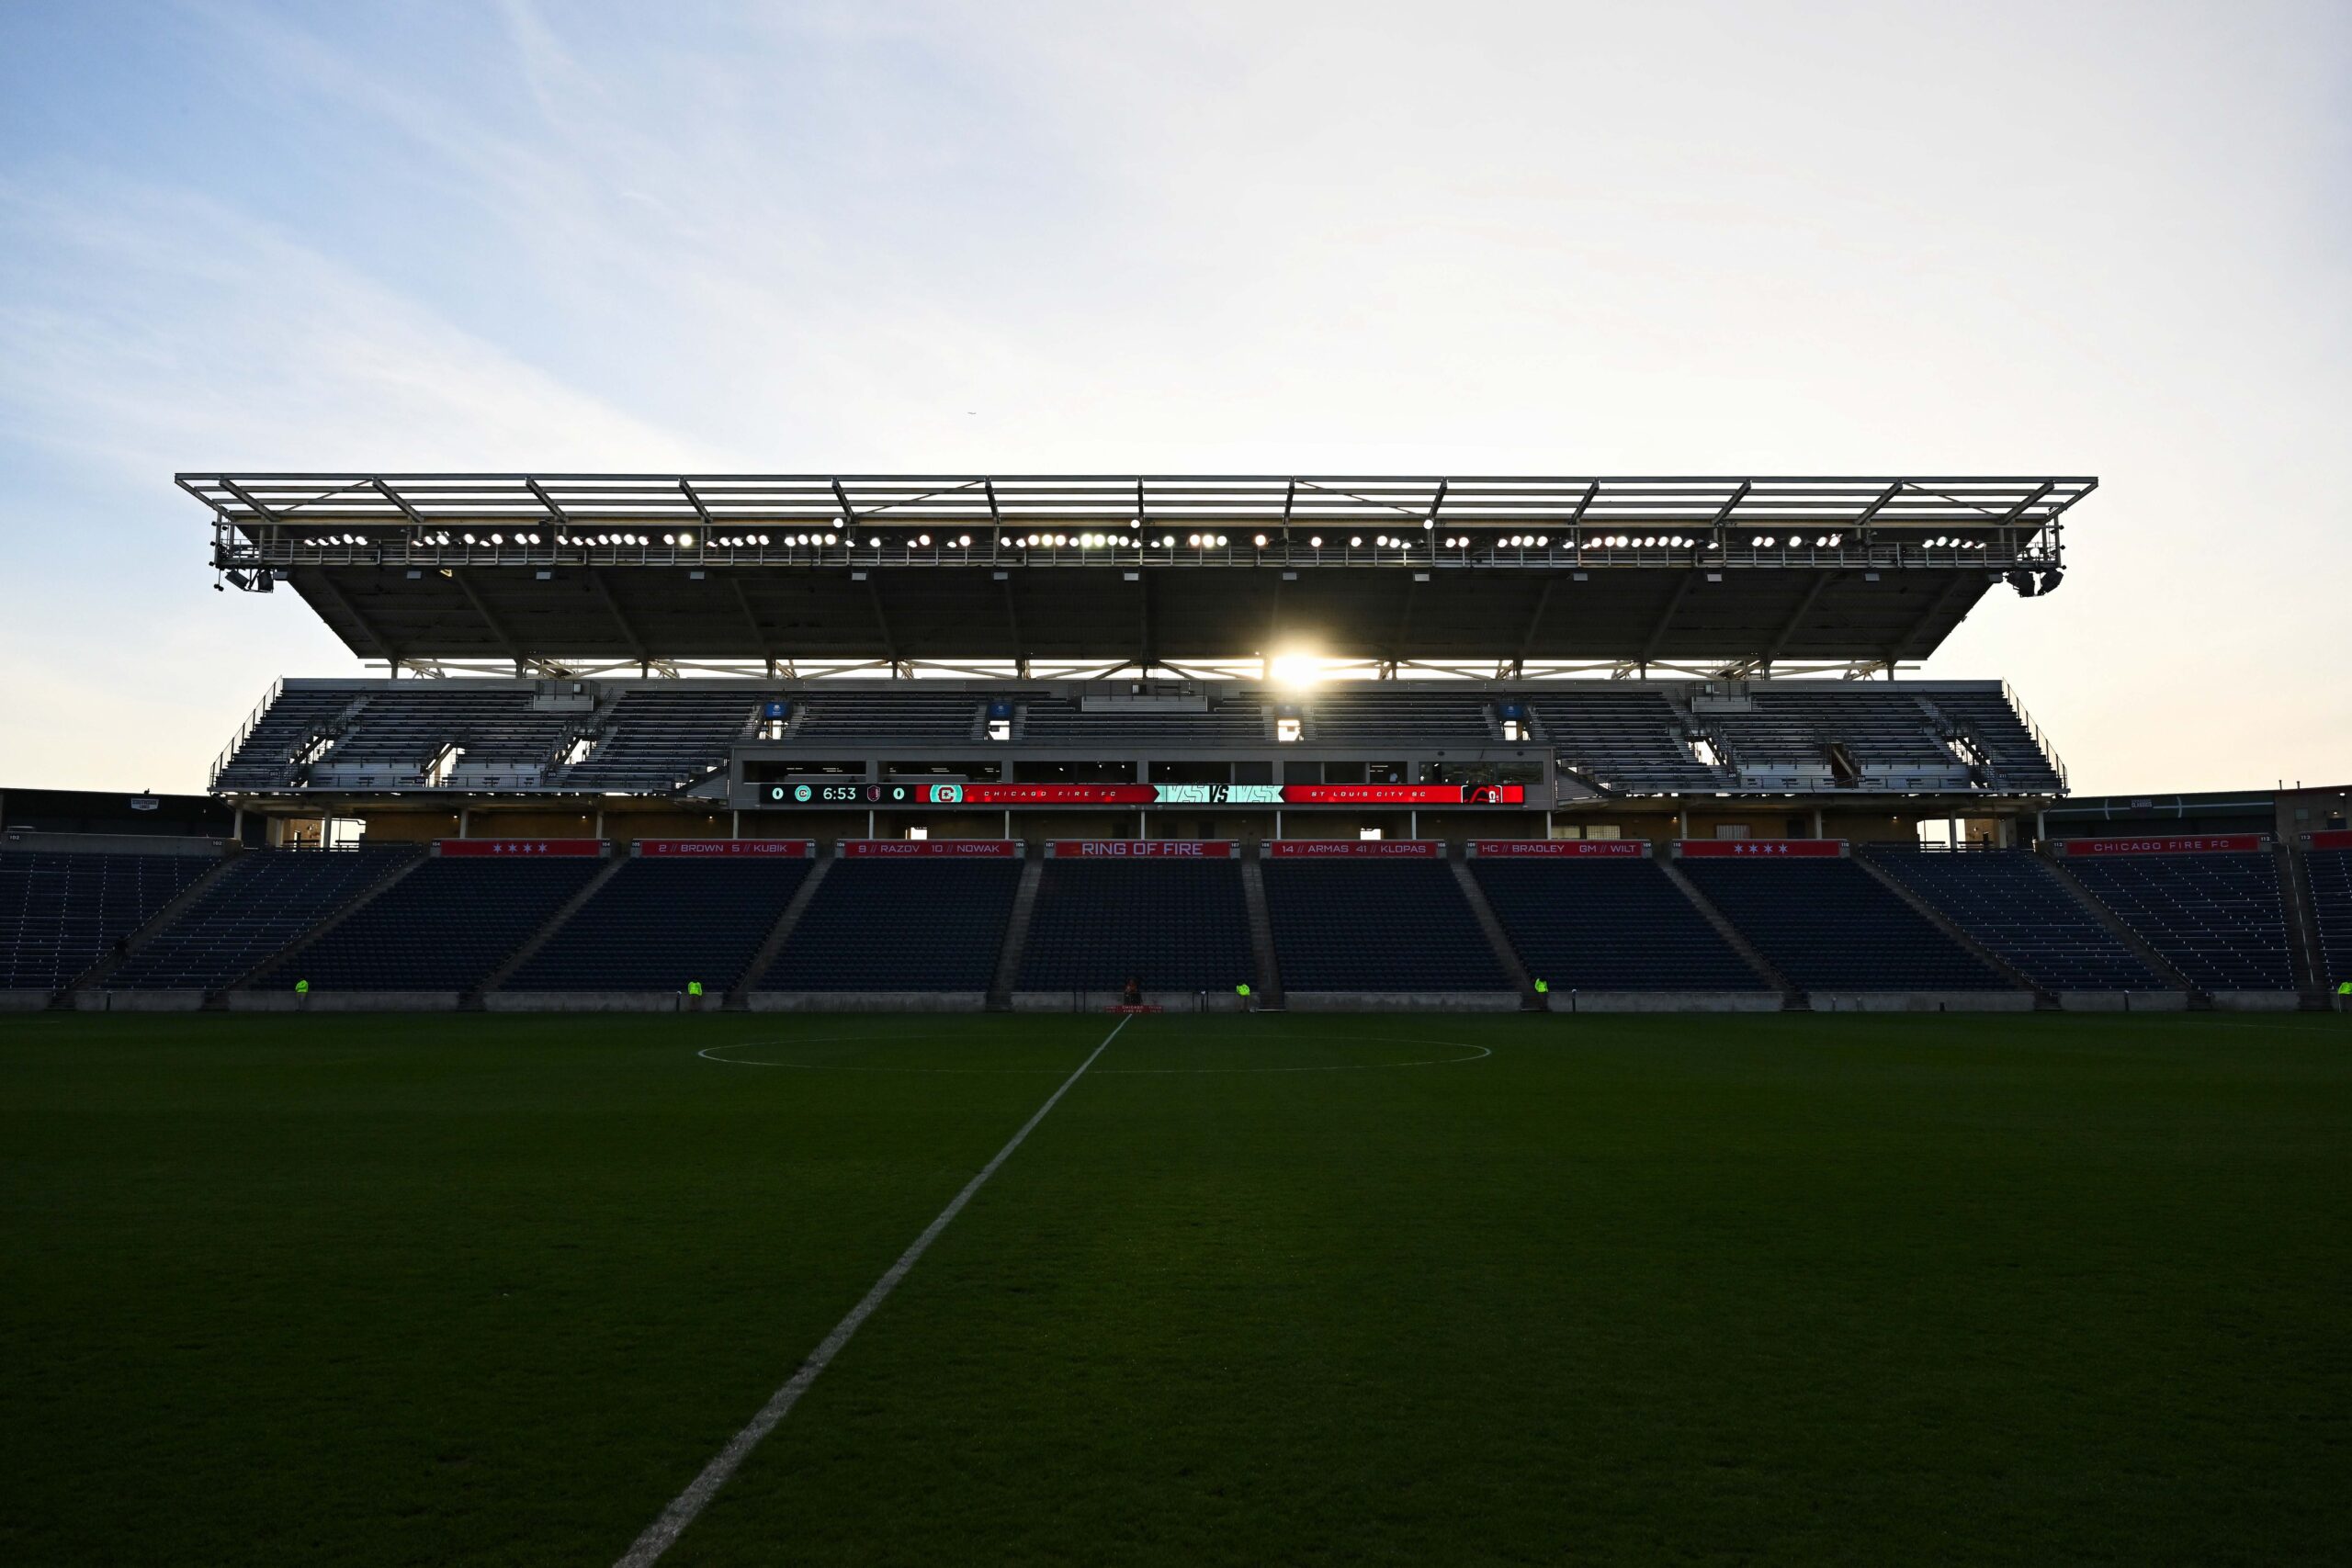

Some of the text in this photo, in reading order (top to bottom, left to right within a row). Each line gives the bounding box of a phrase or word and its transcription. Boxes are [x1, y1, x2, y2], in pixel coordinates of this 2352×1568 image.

[772, 787, 784, 800] 0
[822, 787, 856, 800] 6:53
[893, 787, 905, 800] 0
[1209, 784, 1229, 803] VS
[659, 844, 666, 852] 2
[681, 844, 724, 852] BROWN
[731, 844, 740, 852] 5
[858, 844, 866, 852] 9
[880, 844, 920, 852] RAZOV
[932, 844, 943, 852] 10
[957, 844, 1000, 852] NOWAK
[1081, 843, 1204, 855] RING OF FIRE
[1282, 845, 1294, 853] 14
[1307, 845, 1349, 853] ARMAS
[1355, 845, 1366, 853] 41
[1381, 845, 1426, 853] KLOPAS
[1482, 845, 1498, 853] HC
[1512, 845, 1565, 853] BRADLEY
[1579, 845, 1597, 853] GM
[1610, 845, 1636, 853] WILT
[2094, 840, 2230, 852] CHICAGO FIRE FC
